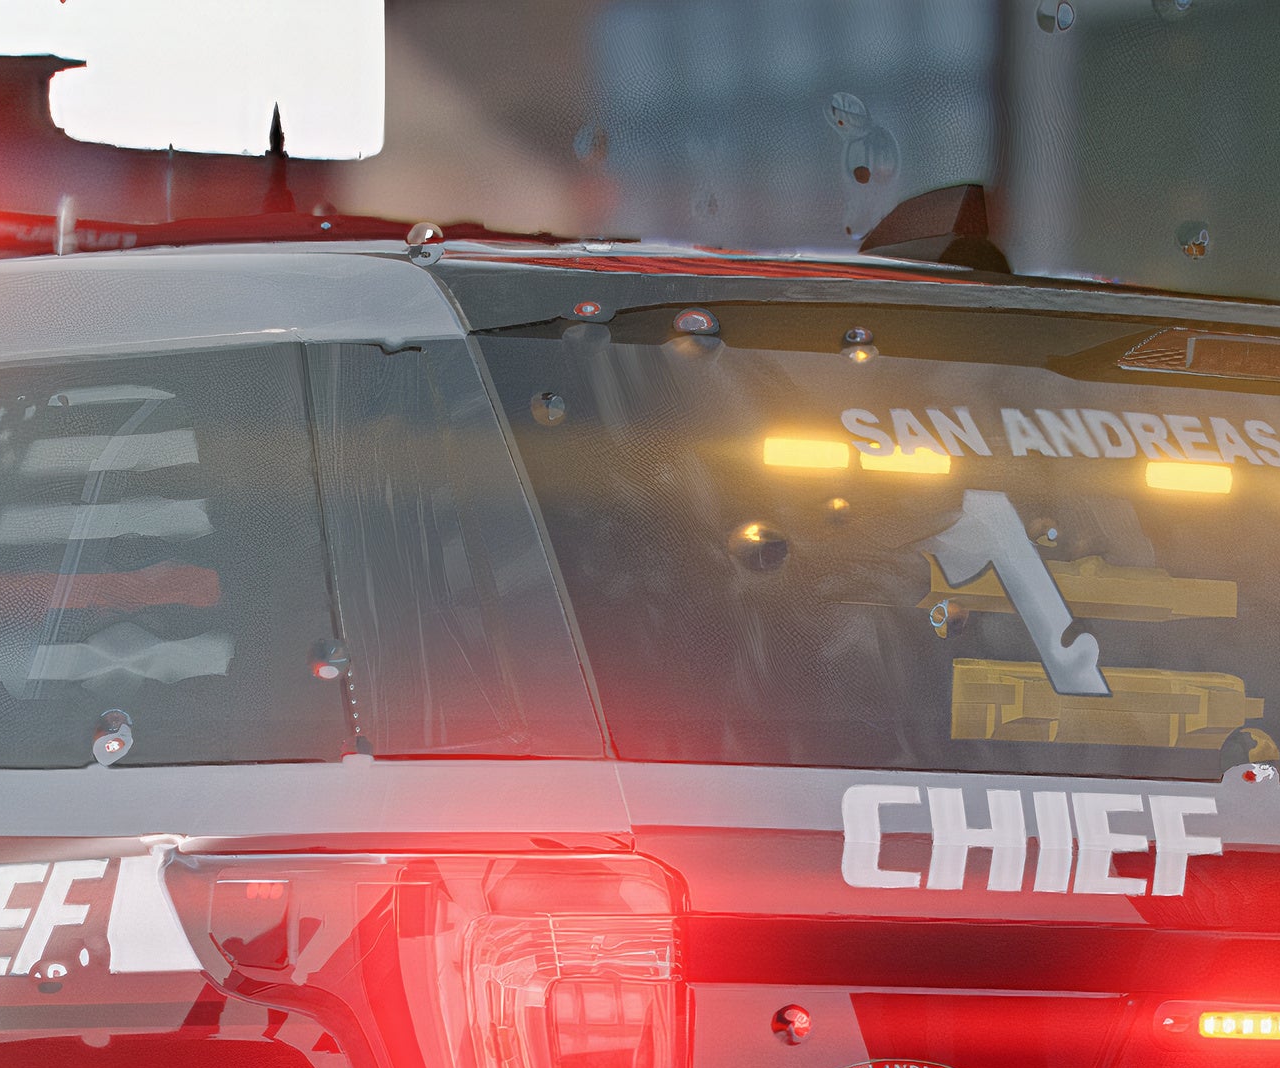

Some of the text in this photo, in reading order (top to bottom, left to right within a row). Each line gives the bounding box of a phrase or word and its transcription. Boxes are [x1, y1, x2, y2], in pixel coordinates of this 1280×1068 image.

[840, 406, 993, 457] SAN
[921, 489, 1113, 697] 1
[841, 784, 1223, 896] CHIEF
